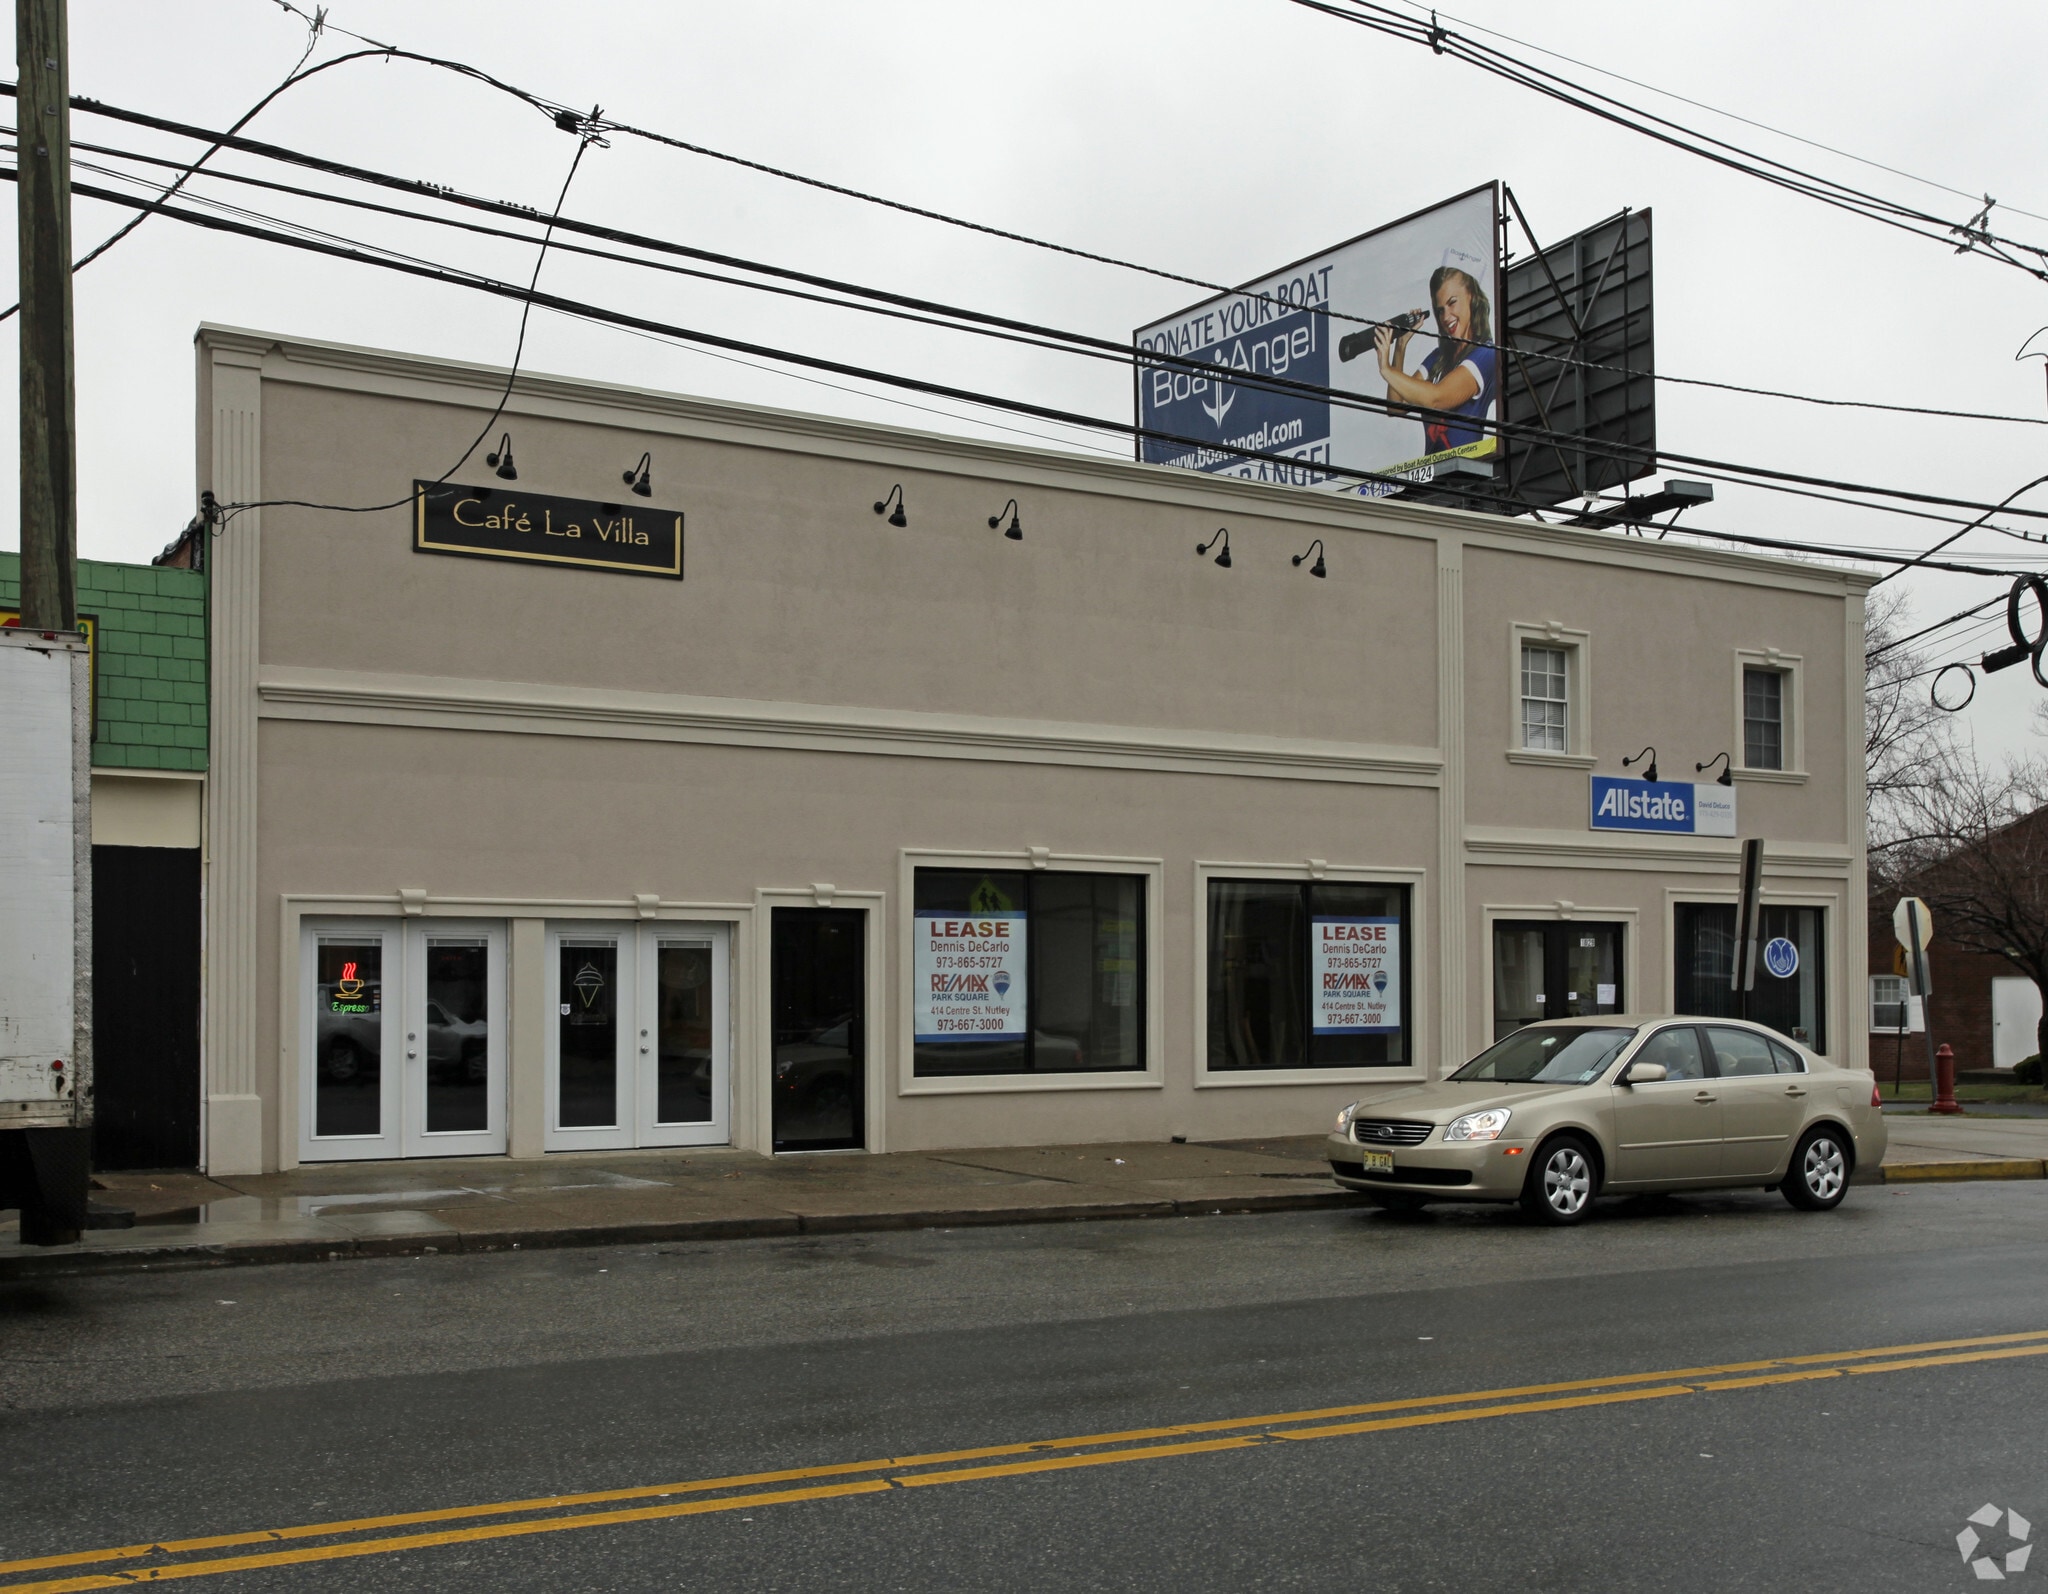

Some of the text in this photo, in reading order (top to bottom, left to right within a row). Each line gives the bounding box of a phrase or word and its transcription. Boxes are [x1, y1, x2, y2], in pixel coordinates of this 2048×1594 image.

[1219, 291, 1272, 337] YOUR
[1278, 265, 1333, 317] BOAT
[1411, 466, 1433, 483] 1424
[453, 498, 649, 546] Café La Villa
[1597, 788, 1685, 821] Allstate
[931, 921, 1010, 938] LEASE
[1323, 926, 1386, 941] LEASE
[930, 940, 1010, 952] Dennis DeCarlo
[1323, 943, 1387, 954] Dennis DeCarlo
[936, 956, 1003, 969] 973-865-5727
[1327, 957, 1382, 968] 973-865-5727
[931, 973, 989, 993] RE/MAX
[1323, 973, 1370, 990] RE/MAX
[931, 993, 989, 1002] PARK SQUARE
[332, 1001, 370, 1016] Espresso
[930, 1005, 1010, 1018] 414 Centre St. Nutley
[1322, 1002, 1333, 1010] 414
[1334, 1002, 1355, 1011] Centre
[1367, 1002, 1387, 1012] Nutley
[937, 1018, 1004, 1032] 973-667-3000
[1327, 1013, 1382, 1025] 973-667-3000
